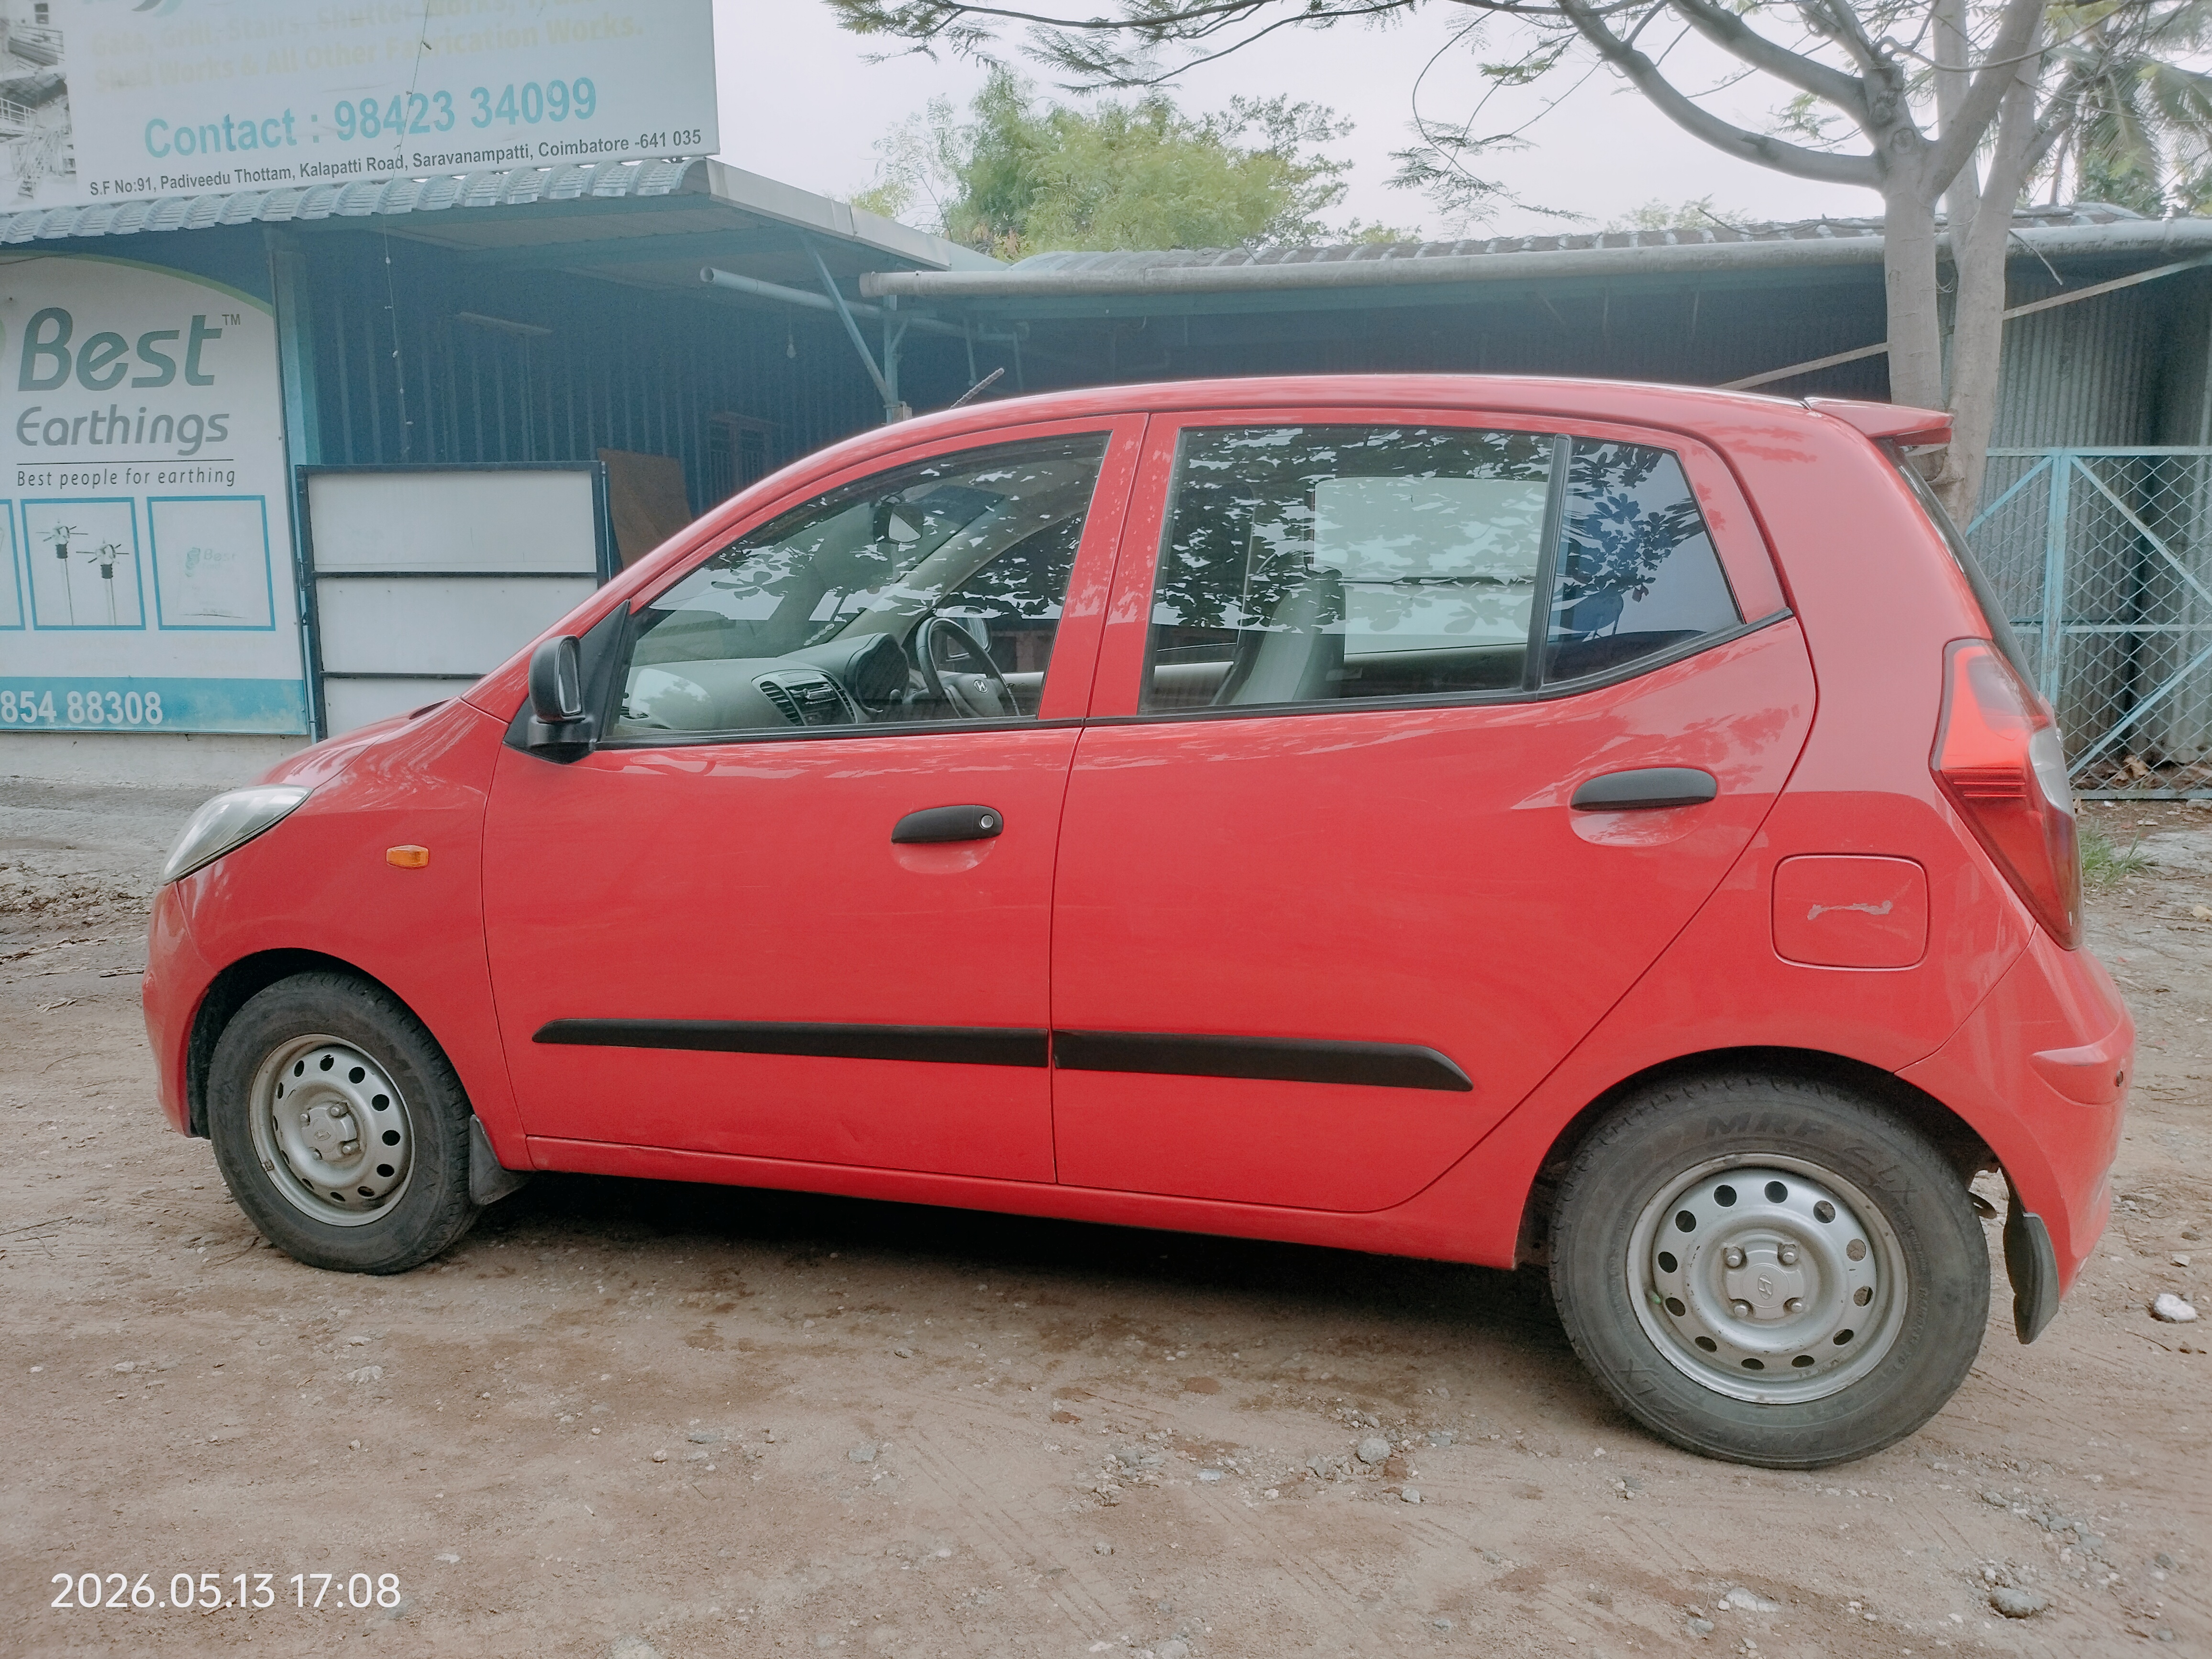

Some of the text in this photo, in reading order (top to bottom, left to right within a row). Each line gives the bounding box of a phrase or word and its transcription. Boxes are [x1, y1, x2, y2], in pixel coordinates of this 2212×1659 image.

[240, 52, 259, 76] &
[266, 47, 299, 74] All
[305, 41, 377, 70] Other
[386, 22, 539, 60] Fabrication
[546, 12, 644, 44] Works.
[145, 108, 297, 158] Contact
[335, 90, 455, 141] 98423
[470, 77, 597, 128] 34099
[114, 177, 156, 194] No:91,
[160, 171, 231, 189] Padiveedu
[234, 167, 296, 183] Thottam,
[299, 158, 362, 178] Kalapatti
[366, 155, 408, 171] Road,
[412, 143, 533, 168] Saravanampatti,
[538, 138, 630, 157] Coimbatore
[673, 129, 701, 146] 035
[18, 307, 223, 391] Best
[16, 404, 230, 456] Earthings
[17, 467, 235, 489] Best people for earthing
[66, 691, 163, 725] 88308
[1704, 1112, 1826, 1138] MRF
